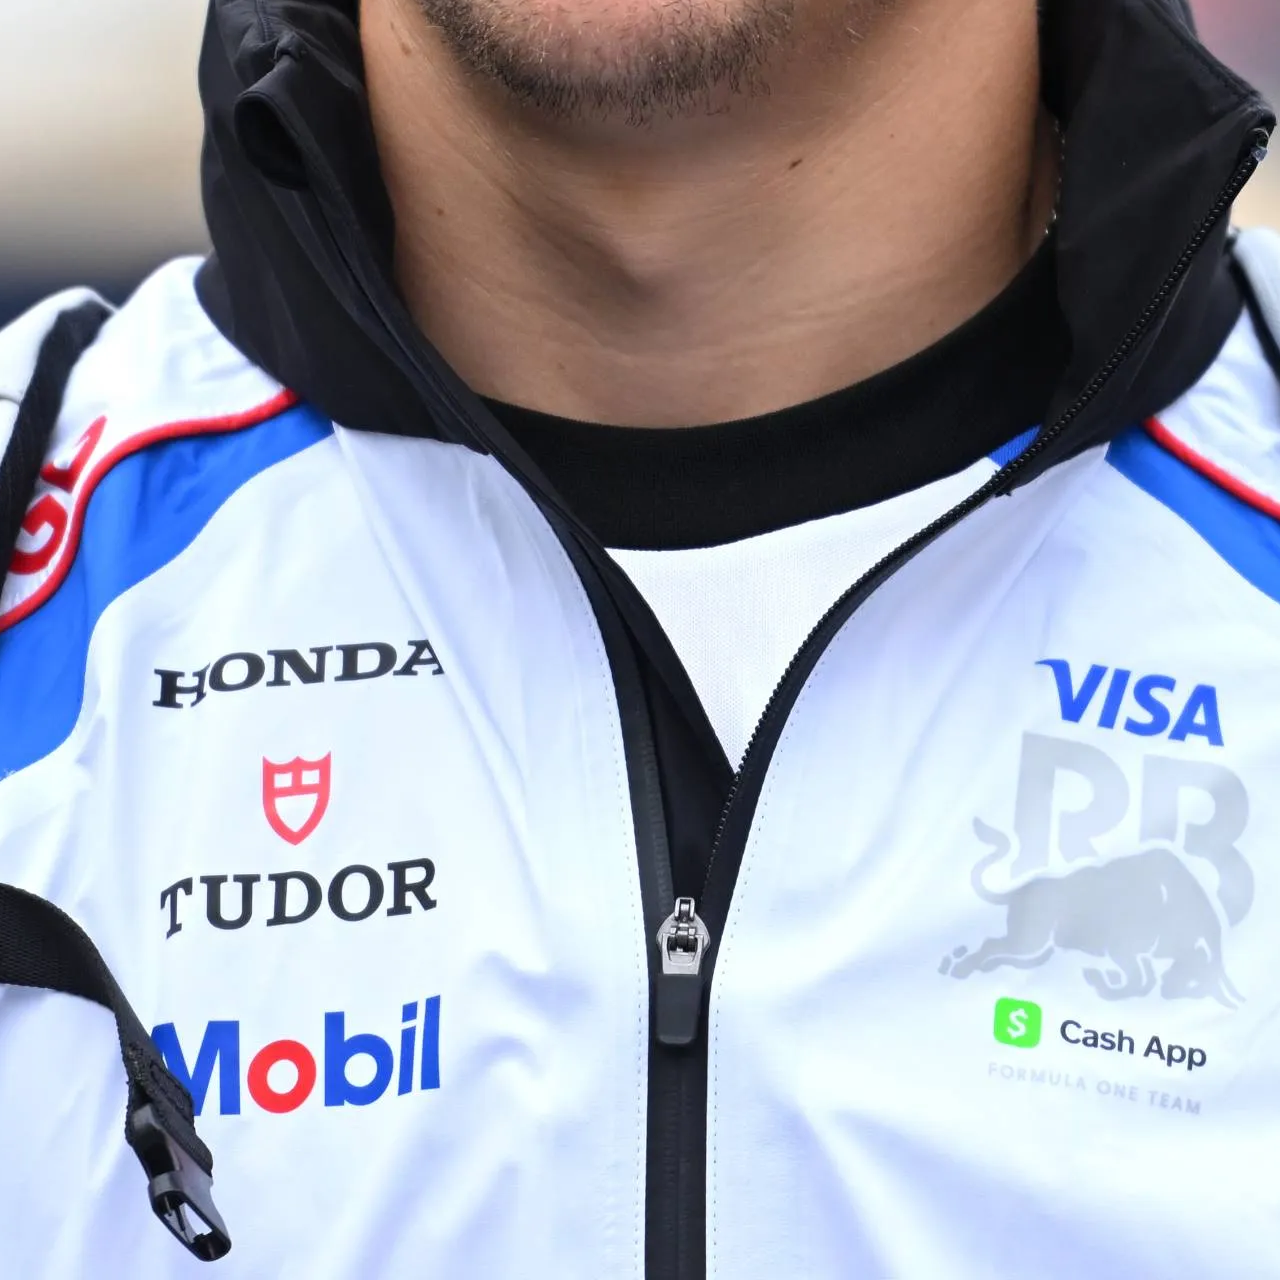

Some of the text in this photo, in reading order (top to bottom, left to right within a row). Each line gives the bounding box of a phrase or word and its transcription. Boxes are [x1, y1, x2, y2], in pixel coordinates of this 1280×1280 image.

[152, 639, 445, 709] HONDA
[1036, 658, 1225, 747] VISA
[160, 857, 437, 940] TUDOR
[150, 994, 441, 1117] Mobil
[1060, 1019, 1135, 1055] Cash
[1143, 1035, 1207, 1071] App
[987, 1061, 1203, 1115] FORMULA ONE TEAM
